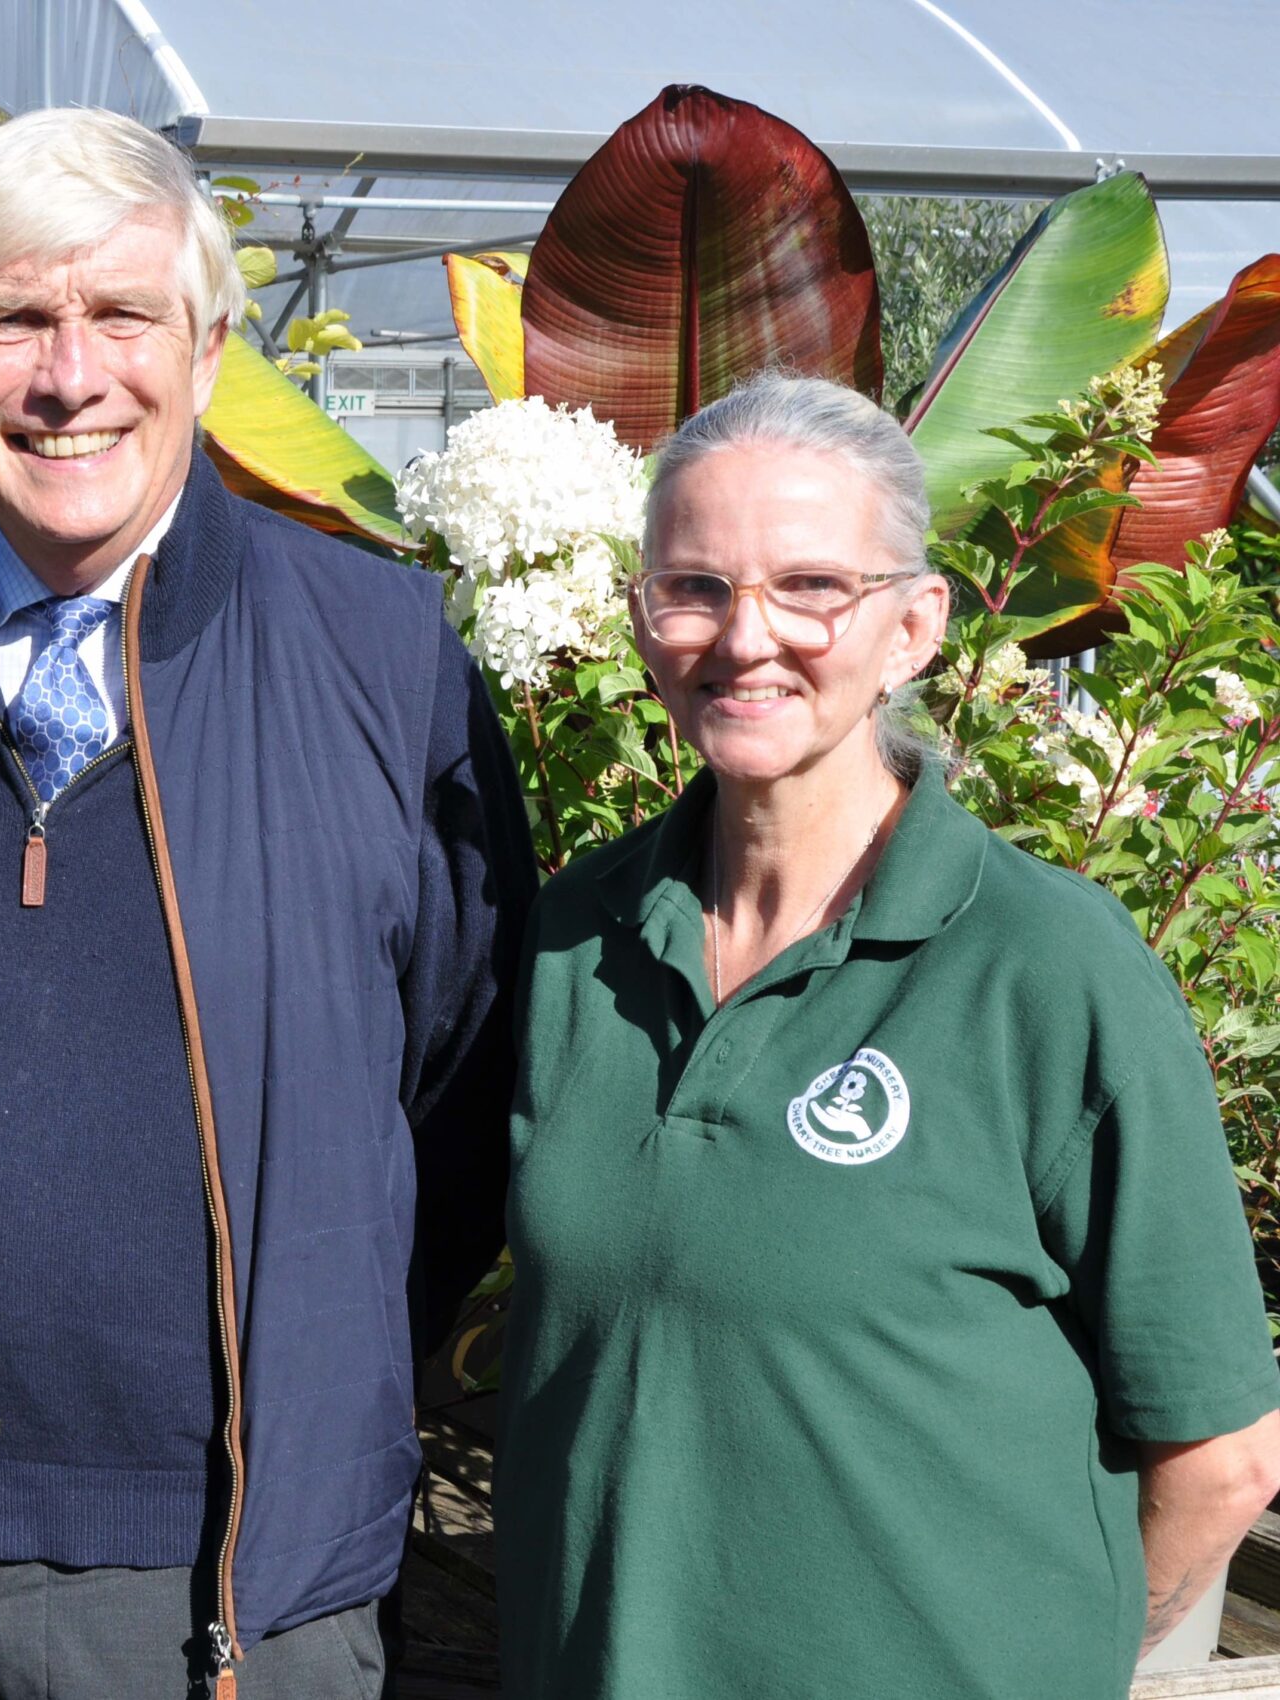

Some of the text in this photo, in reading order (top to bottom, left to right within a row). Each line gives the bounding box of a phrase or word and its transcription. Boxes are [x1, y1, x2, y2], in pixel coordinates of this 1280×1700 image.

[325, 395, 366, 411] EXIT
[864, 1052, 904, 1101] NURSERY
[792, 1102, 899, 1159] CHERRY TREE NURSERY
